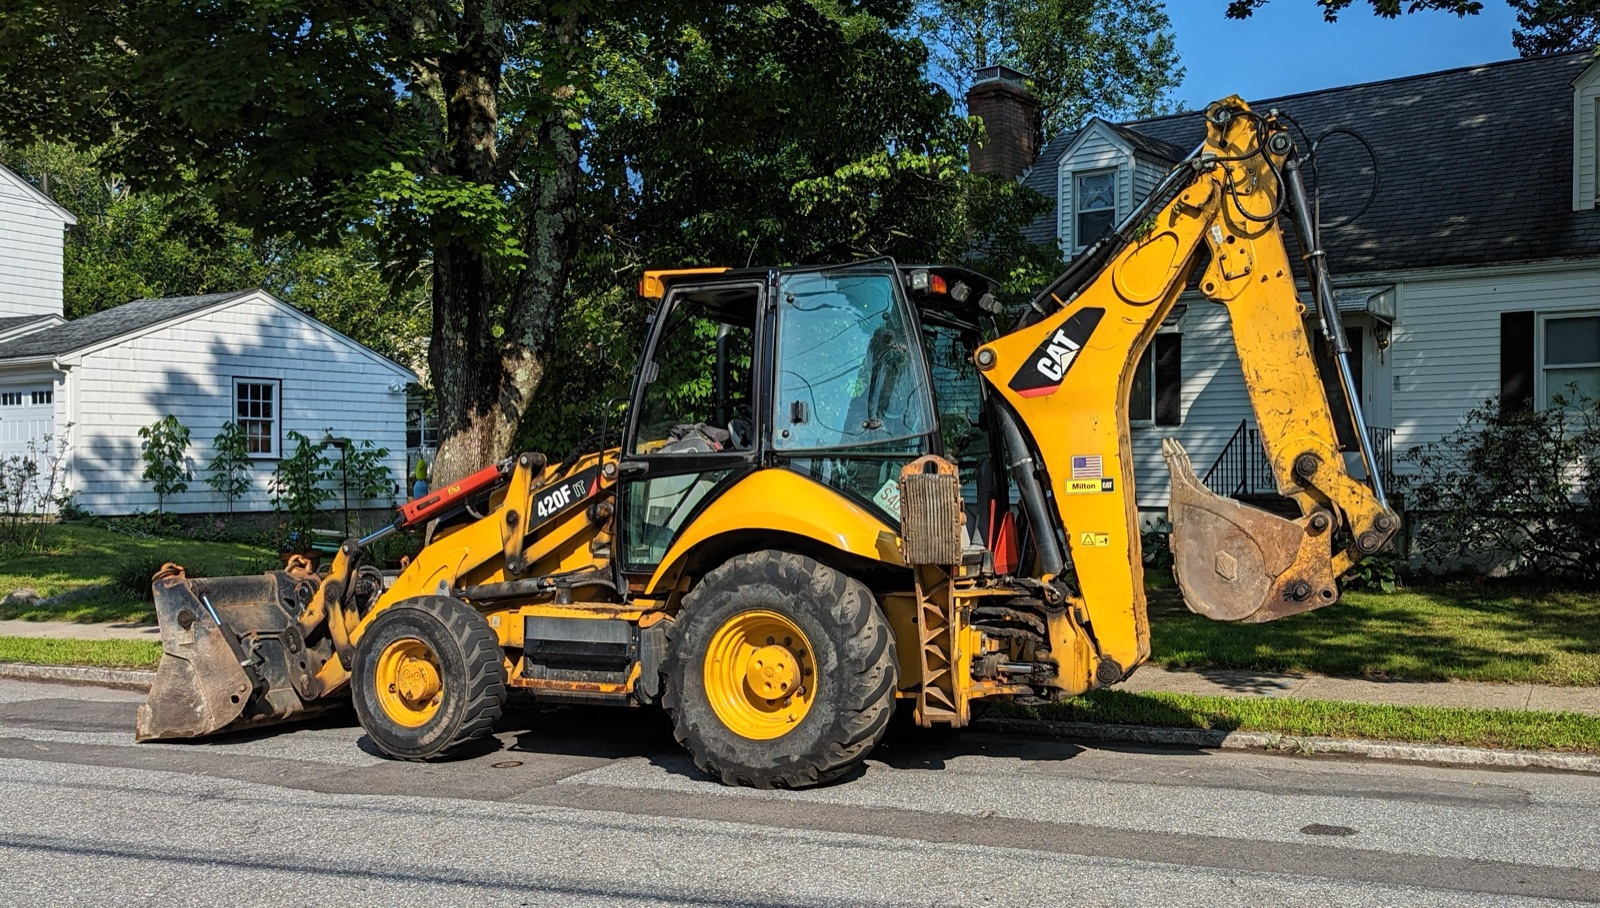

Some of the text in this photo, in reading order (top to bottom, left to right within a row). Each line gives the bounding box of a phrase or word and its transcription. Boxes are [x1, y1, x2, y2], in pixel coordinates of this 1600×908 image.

[1037, 329, 1080, 381] CAT
[537, 484, 571, 517] 420F
[1102, 481, 1113, 489] CAT
